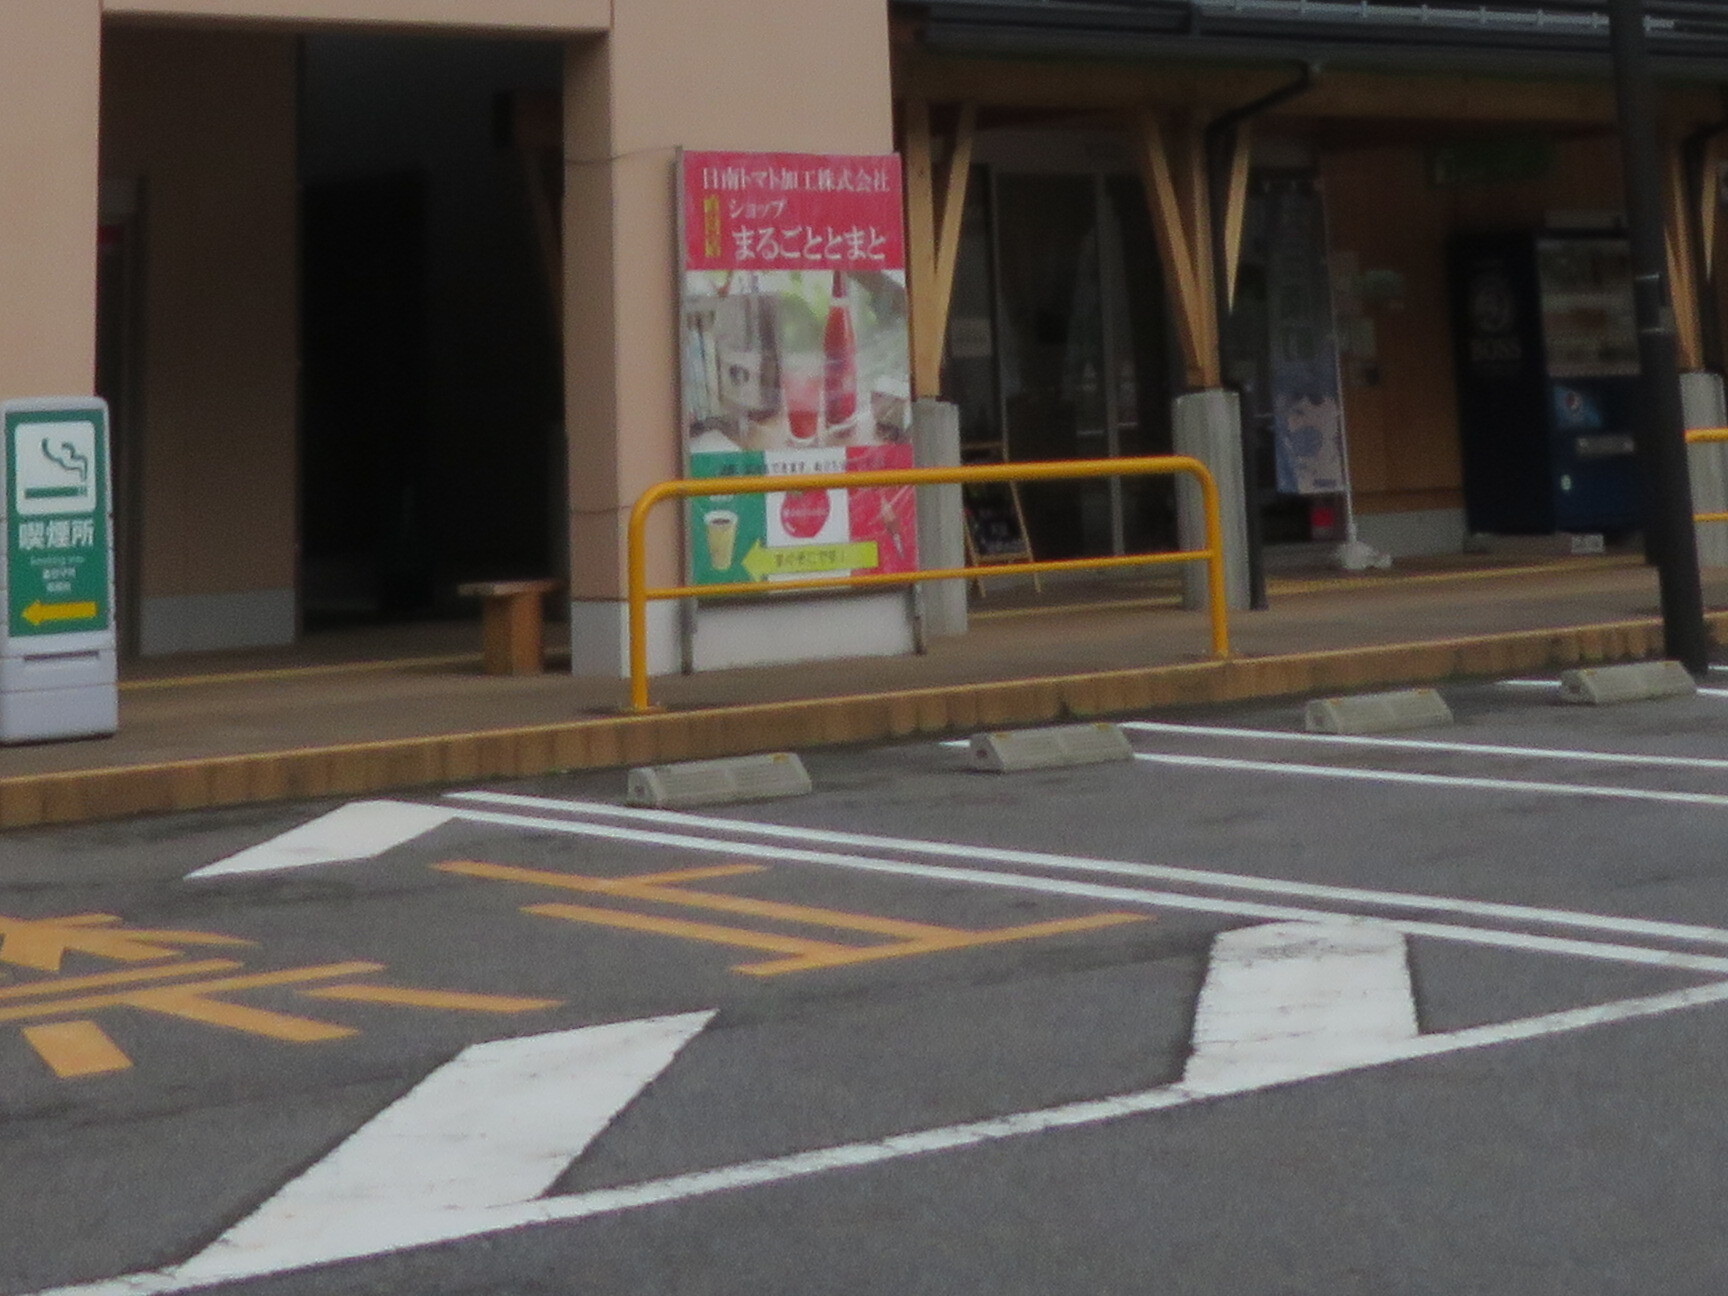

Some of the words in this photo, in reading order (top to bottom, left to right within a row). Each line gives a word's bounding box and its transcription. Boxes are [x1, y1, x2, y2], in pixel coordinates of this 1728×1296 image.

[702, 166, 890, 192] 日南トマト加工株式会社
[728, 197, 788, 219] ショップ
[731, 225, 886, 261] まるごととまと
